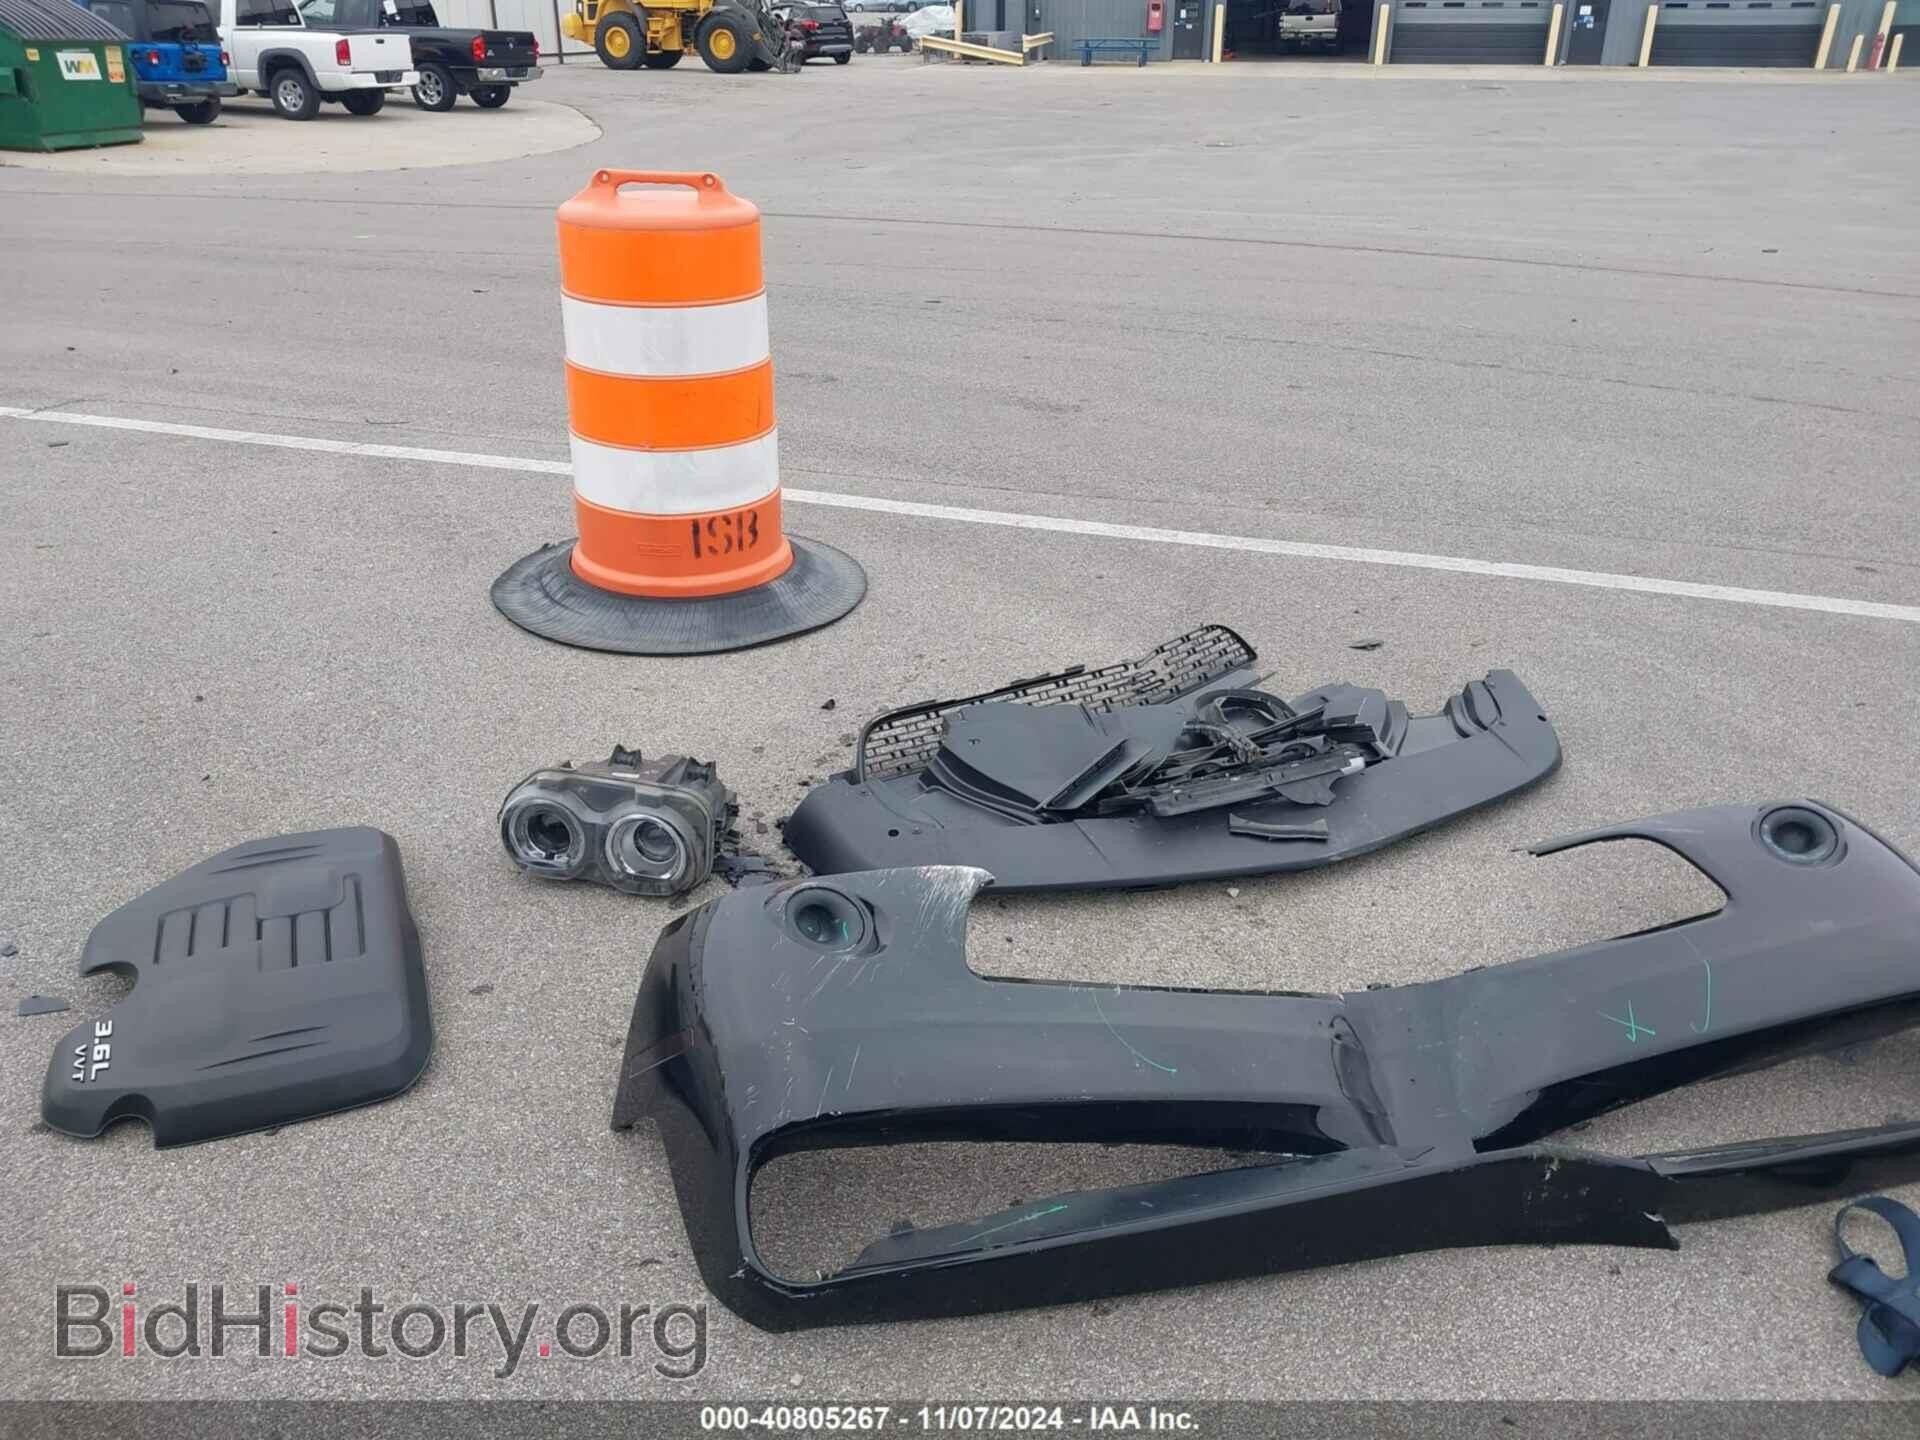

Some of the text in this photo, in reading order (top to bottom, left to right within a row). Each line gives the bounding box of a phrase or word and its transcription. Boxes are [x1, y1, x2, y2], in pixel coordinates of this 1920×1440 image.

[64, 60, 97, 74] WM
[72, 1044, 87, 1081] VVT
[91, 1020, 112, 1080] 3.6L
